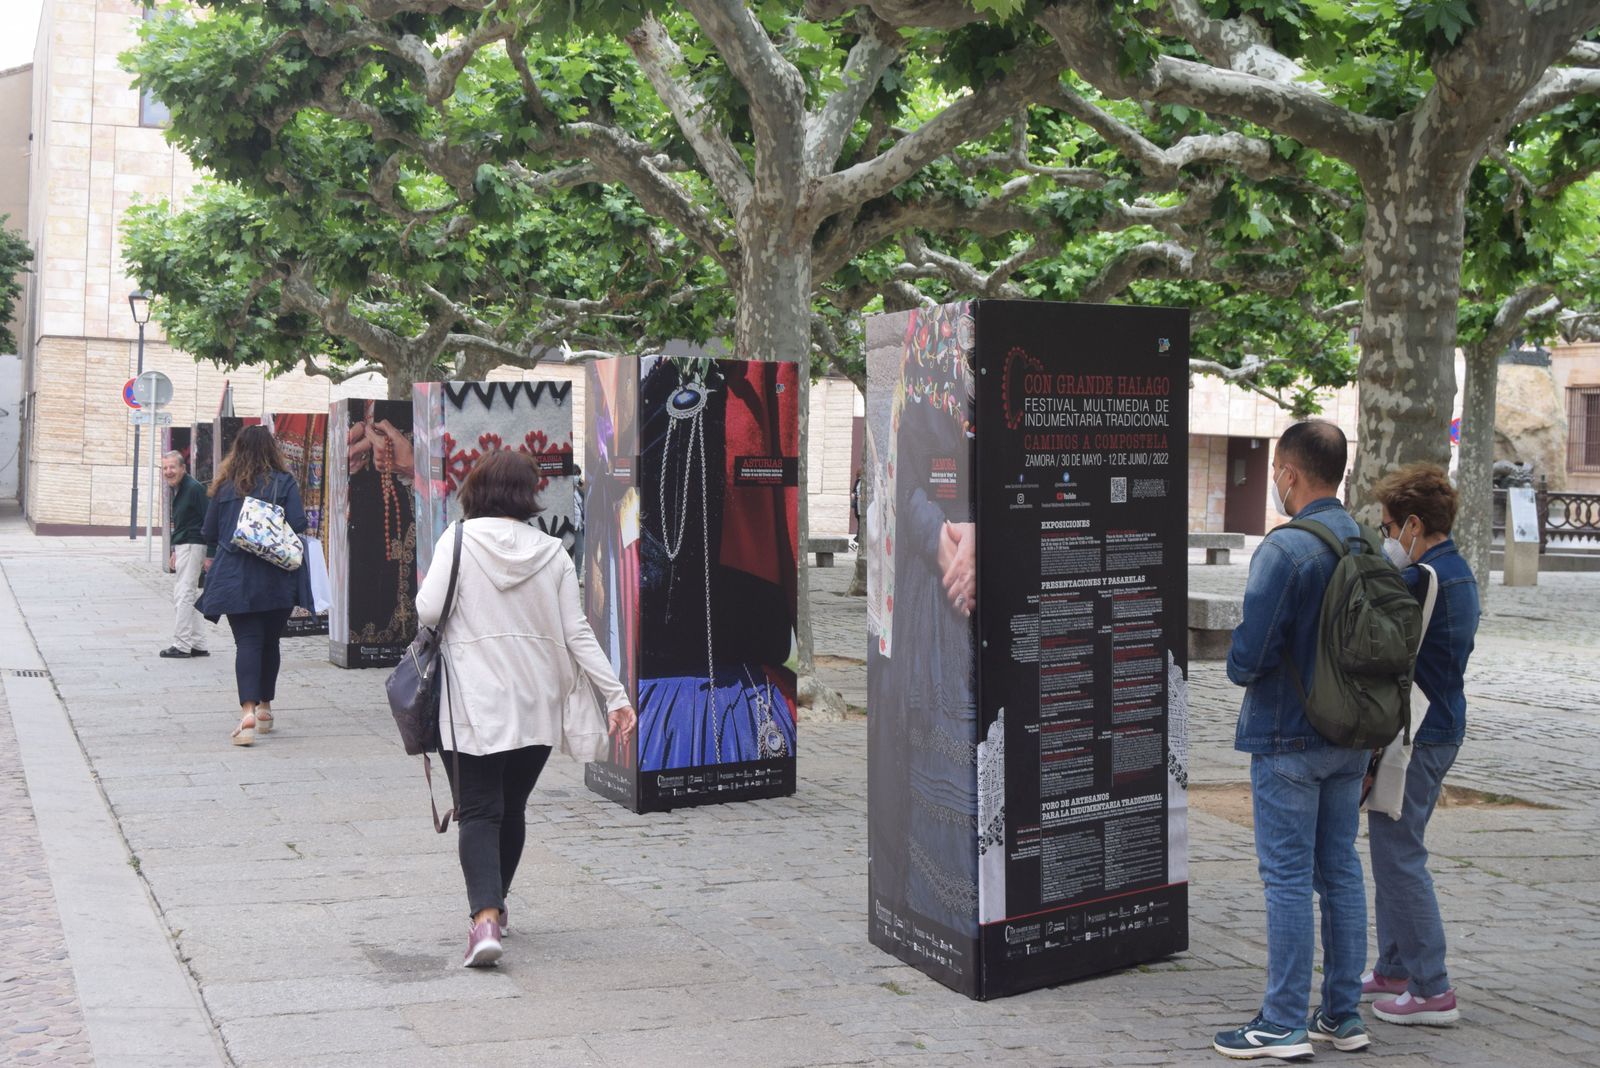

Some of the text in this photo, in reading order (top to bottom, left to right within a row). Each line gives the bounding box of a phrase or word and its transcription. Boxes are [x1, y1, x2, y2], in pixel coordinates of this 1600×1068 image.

[1024, 374, 1170, 395] CON GRANDE HALAGO
[1024, 398, 1170, 413] FESTIVAL MULTIMEDIA DE
[1024, 413, 1170, 427] INDUMENTARIA TRADICIONAL
[1024, 433, 1168, 450] CAMINOS A COMPOSTELA
[742, 458, 783, 468] ASTURIAS
[1025, 454, 1055, 467] ZAMORA
[1061, 453, 1070, 466] 30
[1071, 453, 1081, 466] DE
[1082, 453, 1102, 466] MAYO
[1109, 453, 1117, 465] 12
[1118, 453, 1127, 465] DE
[1128, 452, 1148, 465] JUNIO
[1153, 452, 1169, 465] 2022
[1041, 520, 1091, 530] EXPOSICIONES
[1041, 575, 1146, 590] PRESENTACIONES Y PASARELAS
[1042, 792, 1110, 811] FORO DE ARTESANOS
[1042, 793, 1163, 821] PARA LA INDUMENTARIA TRADICIONAL
